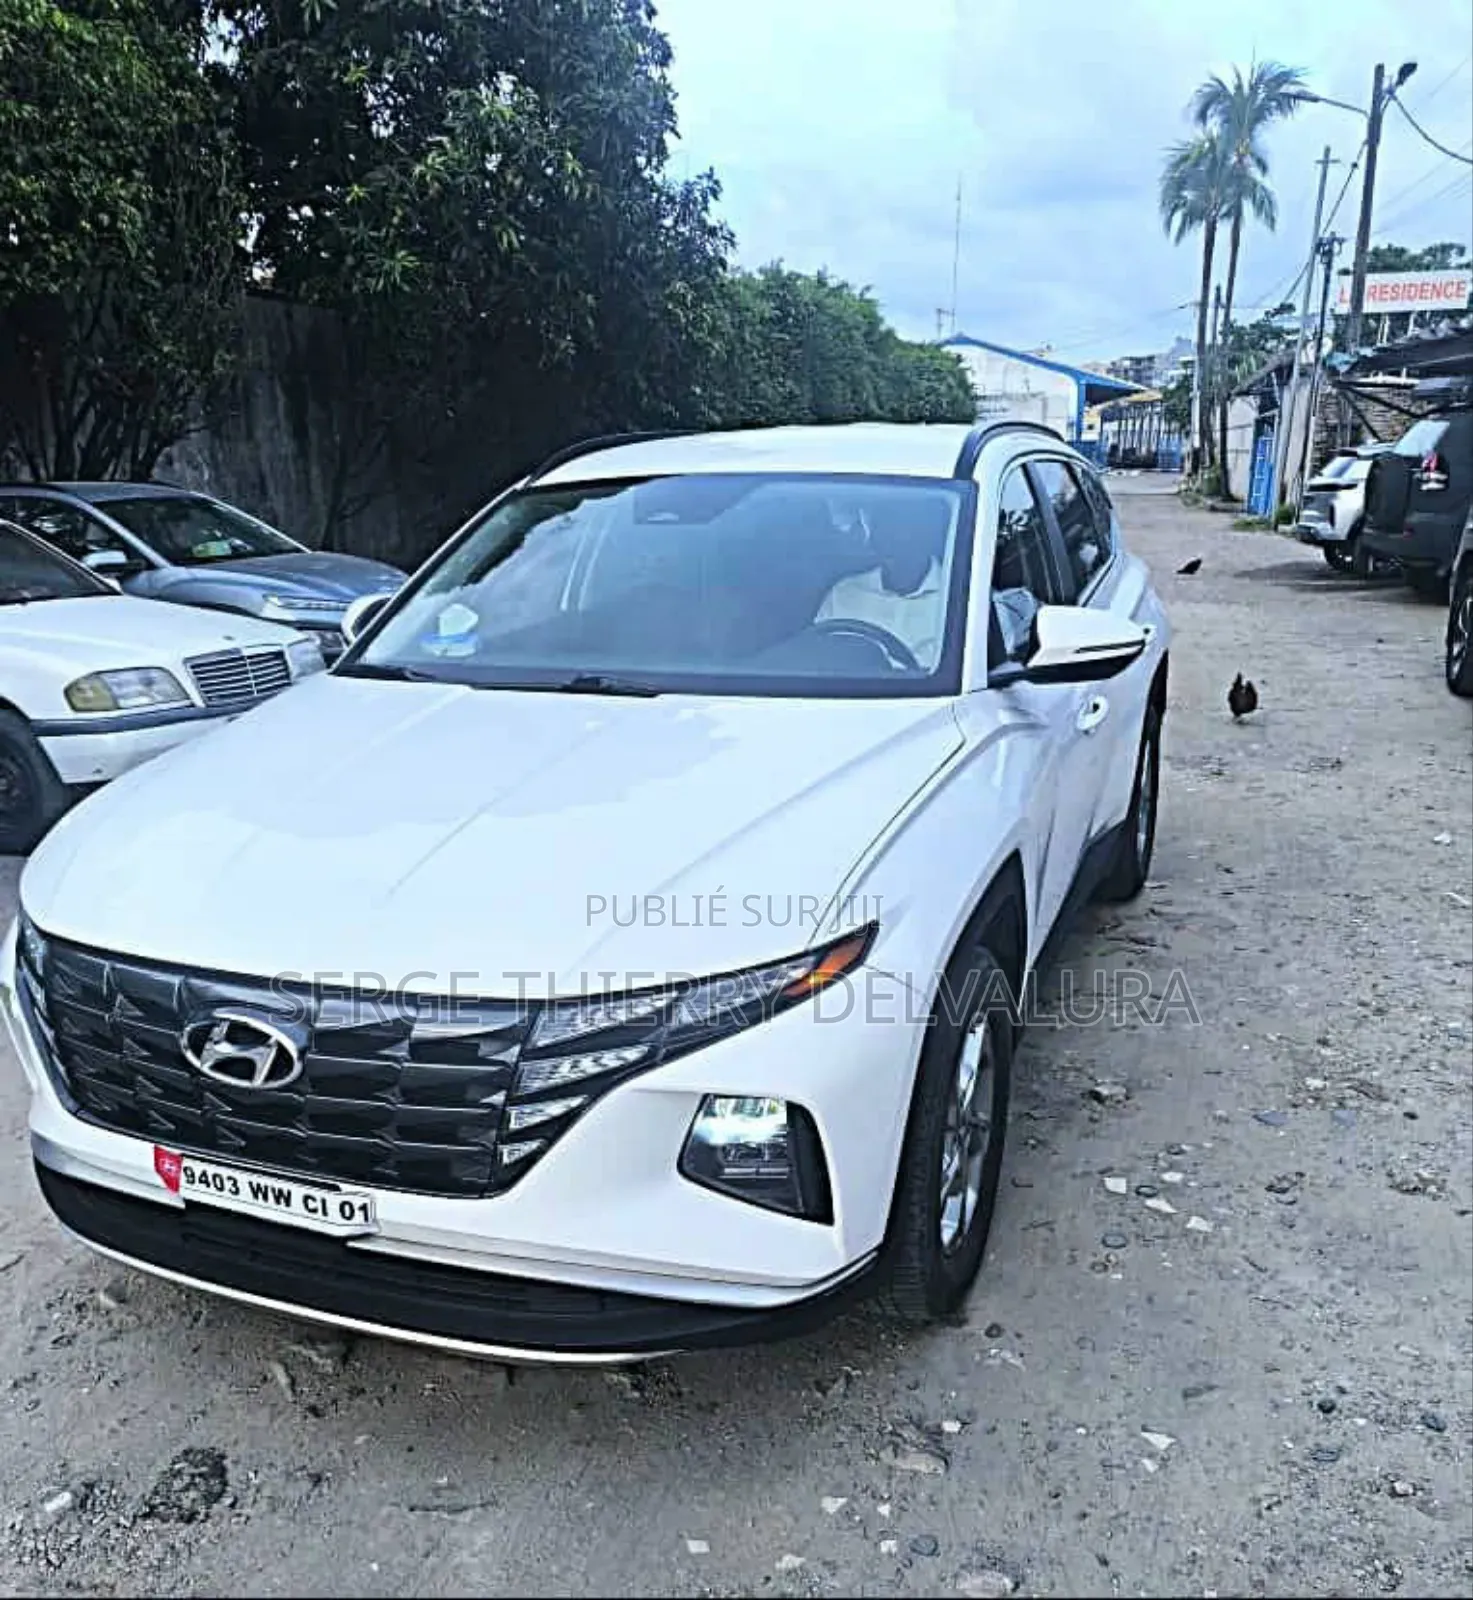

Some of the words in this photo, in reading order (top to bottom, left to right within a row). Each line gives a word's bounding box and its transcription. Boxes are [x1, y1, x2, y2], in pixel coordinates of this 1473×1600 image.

[1368, 281, 1466, 302] RESIDENCE
[183, 1167, 240, 1196] 9403
[248, 1181, 292, 1208] WW
[303, 1195, 329, 1217] CI
[339, 1200, 371, 1222] 01
